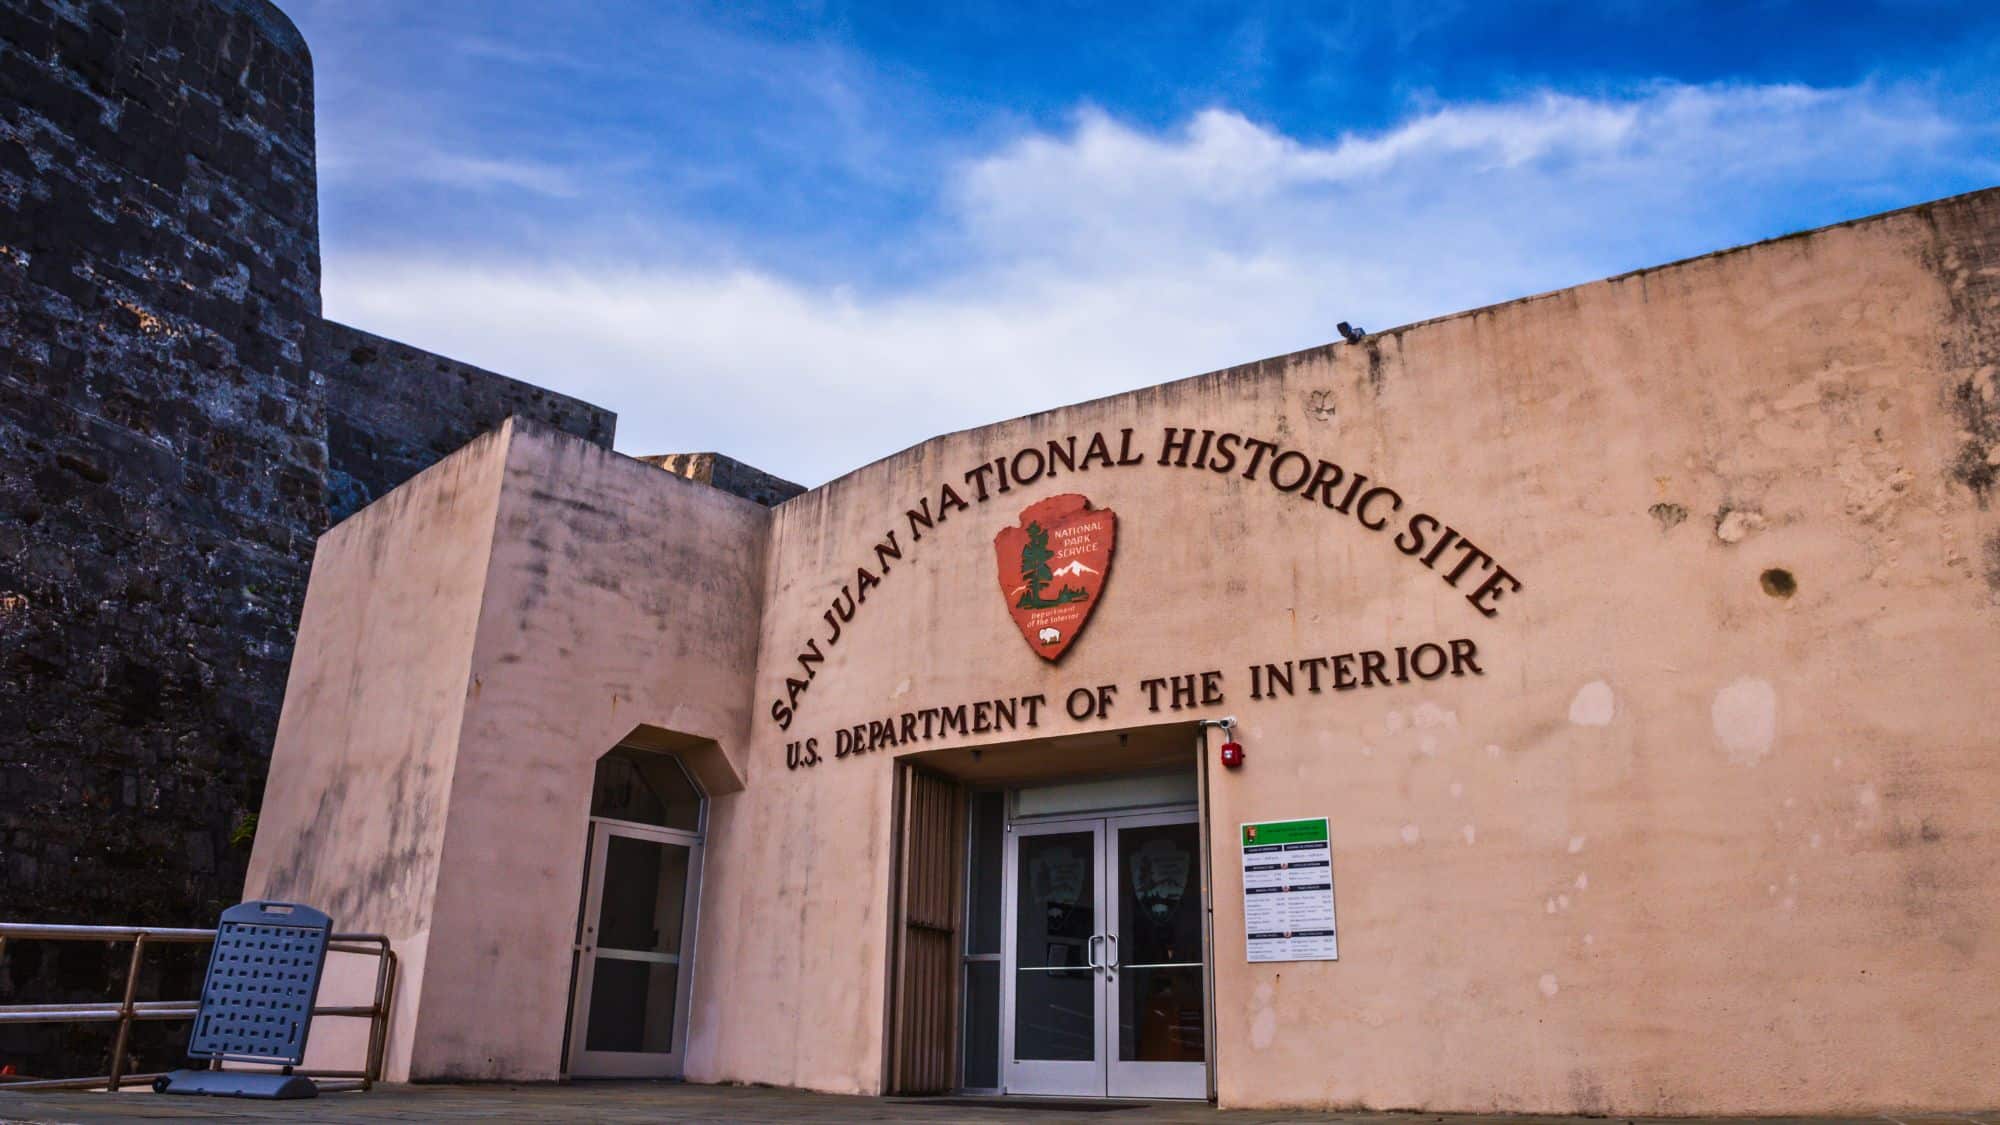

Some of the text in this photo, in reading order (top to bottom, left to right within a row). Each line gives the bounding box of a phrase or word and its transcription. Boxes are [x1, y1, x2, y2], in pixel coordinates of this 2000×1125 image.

[1055, 521, 1103, 538] NATIONAL
[1064, 534, 1090, 547] PARK
[1056, 542, 1098, 559] SERVICE
[771, 427, 1522, 731] SAN JUAN NATIONAL HISTORIC SITE
[786, 638, 1483, 770] U.S. DEPARTMENT OF THE INTERIOR
